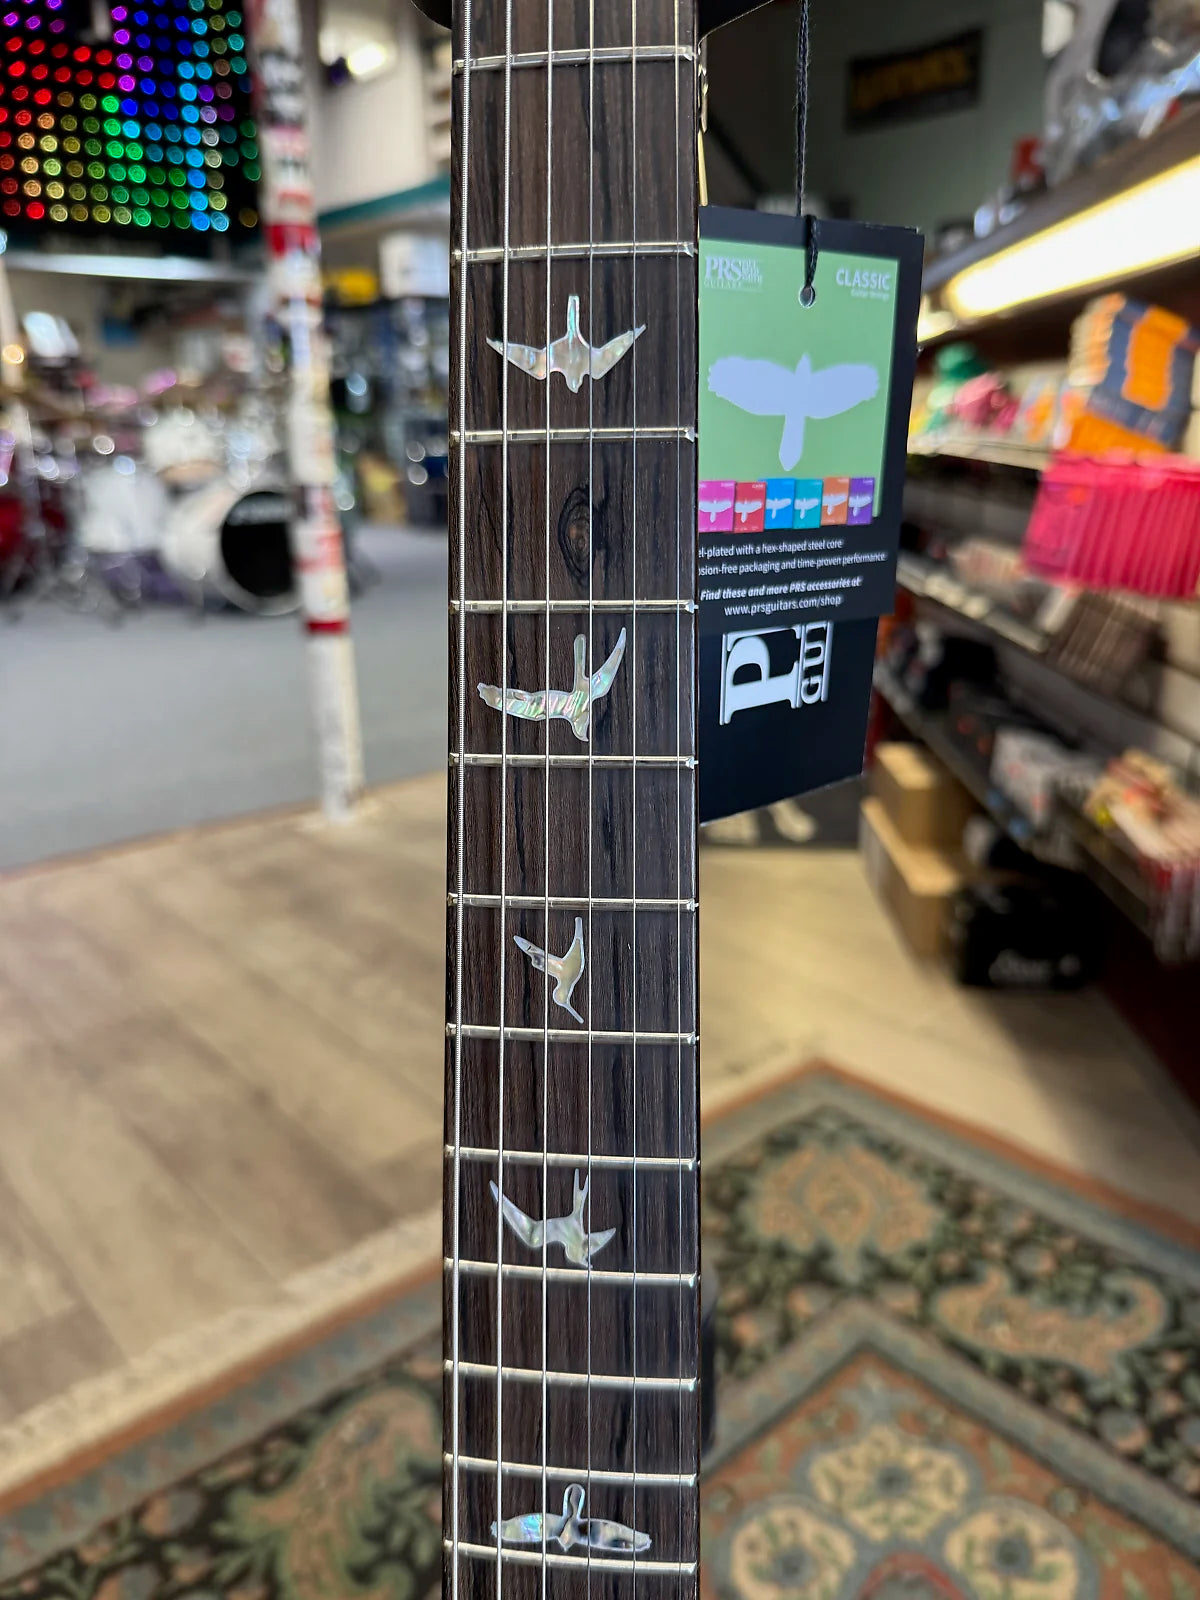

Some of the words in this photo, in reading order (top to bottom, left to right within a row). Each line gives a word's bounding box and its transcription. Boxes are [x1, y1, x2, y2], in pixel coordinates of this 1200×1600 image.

[705, 255, 742, 281] PRS
[836, 268, 891, 291] CLASSIC
[735, 543, 754, 556] with
[755, 546, 761, 554] a
[761, 539, 807, 555] hex-shaped
[807, 539, 826, 551] steel
[826, 539, 843, 549] core
[738, 560, 780, 575] packaging
[780, 557, 797, 570] and
[797, 556, 841, 570] time-proven
[841, 552, 887, 567] performance
[700, 589, 721, 601] Find
[722, 587, 747, 600] these
[747, 584, 766, 597] and
[766, 585, 789, 595] more
[789, 582, 807, 594] PRS
[806, 577, 851, 592] accessories
[851, 576, 863, 587] at
[724, 594, 842, 616] www.prsguitars.com/shop
